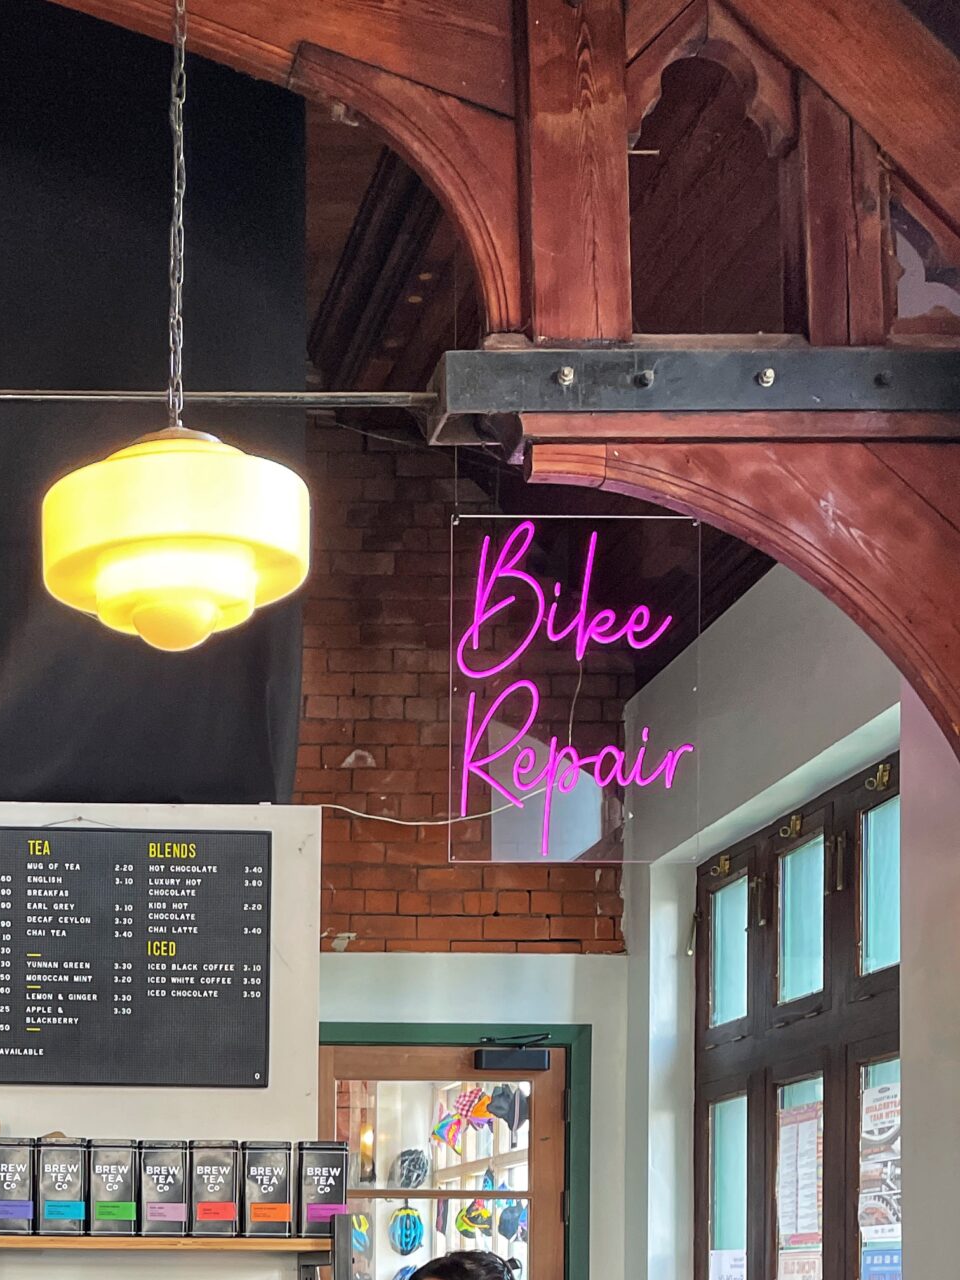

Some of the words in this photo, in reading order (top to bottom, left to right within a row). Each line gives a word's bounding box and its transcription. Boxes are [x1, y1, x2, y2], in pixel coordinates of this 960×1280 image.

[457, 520, 673, 679] Bike
[461, 680, 695, 857] Repair
[28, 840, 50, 855] TEA
[149, 843, 196, 858] BLENDS
[170, 865, 217, 873] CHOCOLATE
[27, 889, 68, 897] BREAKFAS
[148, 941, 176, 956] ICED
[44, 1163, 79, 1173] BREW
[95, 1164, 129, 1174] BREW
[146, 1165, 180, 1175] BREW
[196, 1165, 231, 1175] BREW
[250, 1166, 284, 1176] BREW
[306, 1166, 341, 1176] BREW
[50, 1173, 73, 1182] TEA
[101, 1173, 124, 1183] TEA
[152, 1175, 175, 1185] TEA
[203, 1174, 226, 1184] TEA
[256, 1176, 279, 1185] TEA
[312, 1176, 335, 1186] TEA
